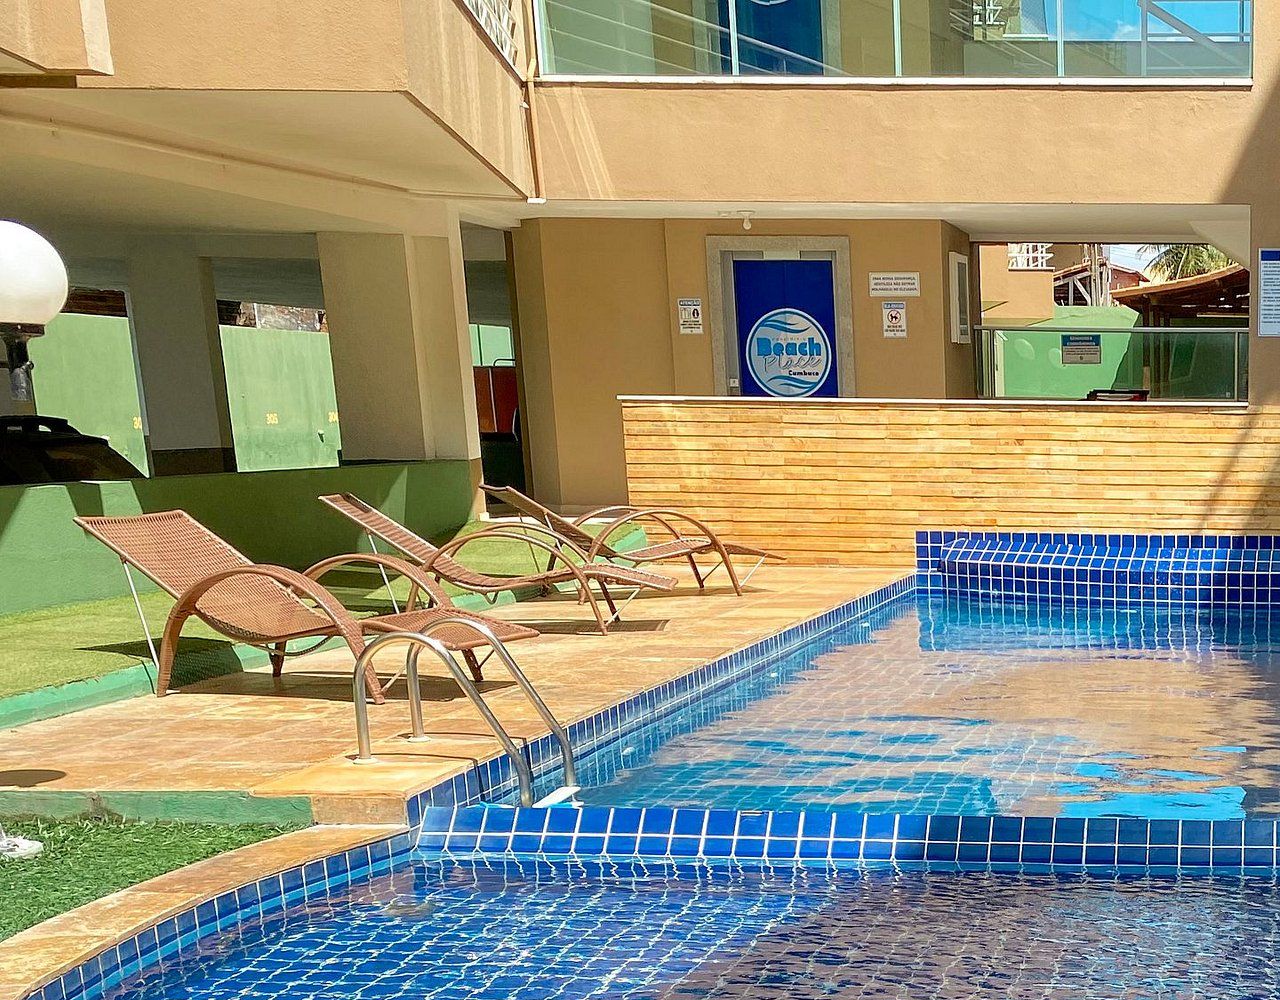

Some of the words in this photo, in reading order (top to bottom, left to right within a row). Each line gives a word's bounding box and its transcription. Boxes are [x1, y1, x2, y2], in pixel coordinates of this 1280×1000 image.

[757, 337, 822, 356] Beach
[763, 354, 821, 373] Place
[788, 369, 820, 377] Cumbuco
[133, 416, 143, 430] 30
